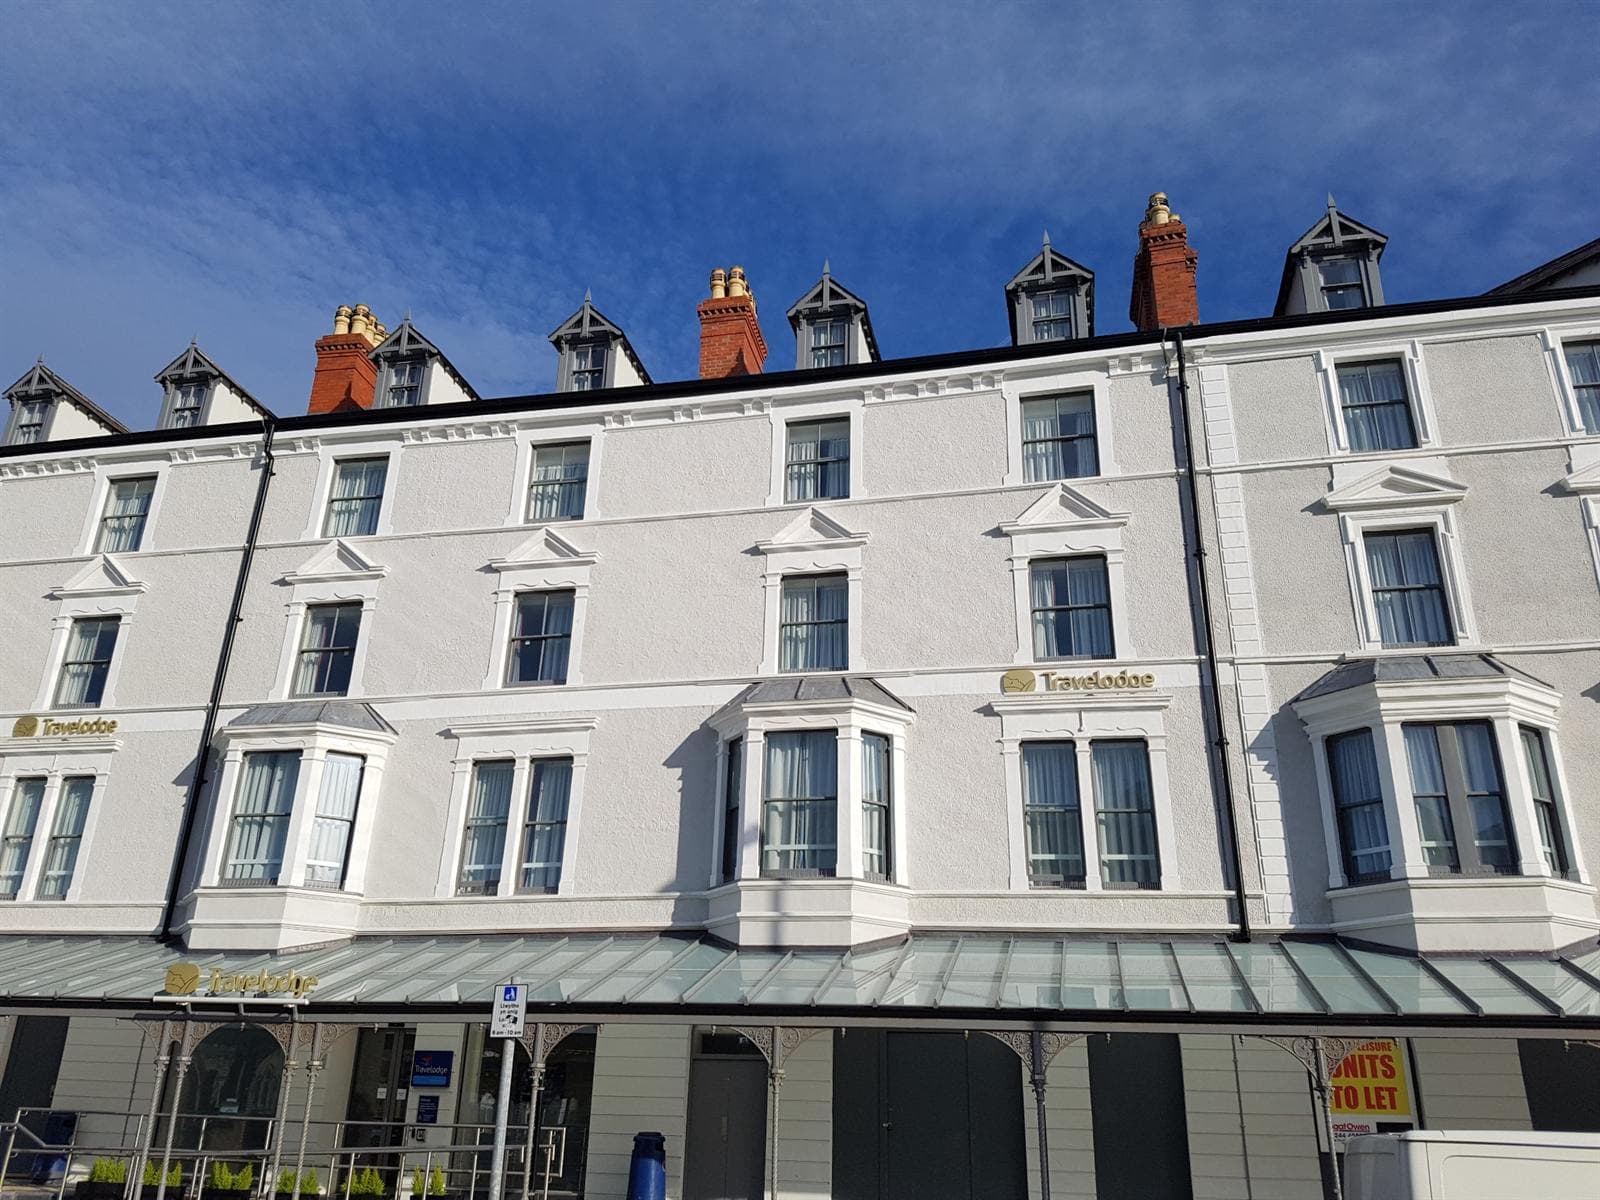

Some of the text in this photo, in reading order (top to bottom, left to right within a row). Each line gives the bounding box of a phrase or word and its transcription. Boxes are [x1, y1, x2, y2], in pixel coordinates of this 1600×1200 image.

[1040, 669, 1155, 691] Travelodge
[42, 716, 118, 736] Travelodge
[209, 968, 318, 998] Travelodge
[1357, 1041, 1393, 1052] EISURE
[415, 1065, 449, 1074] Travelodge
[1332, 1085, 1398, 1110] TO LET
